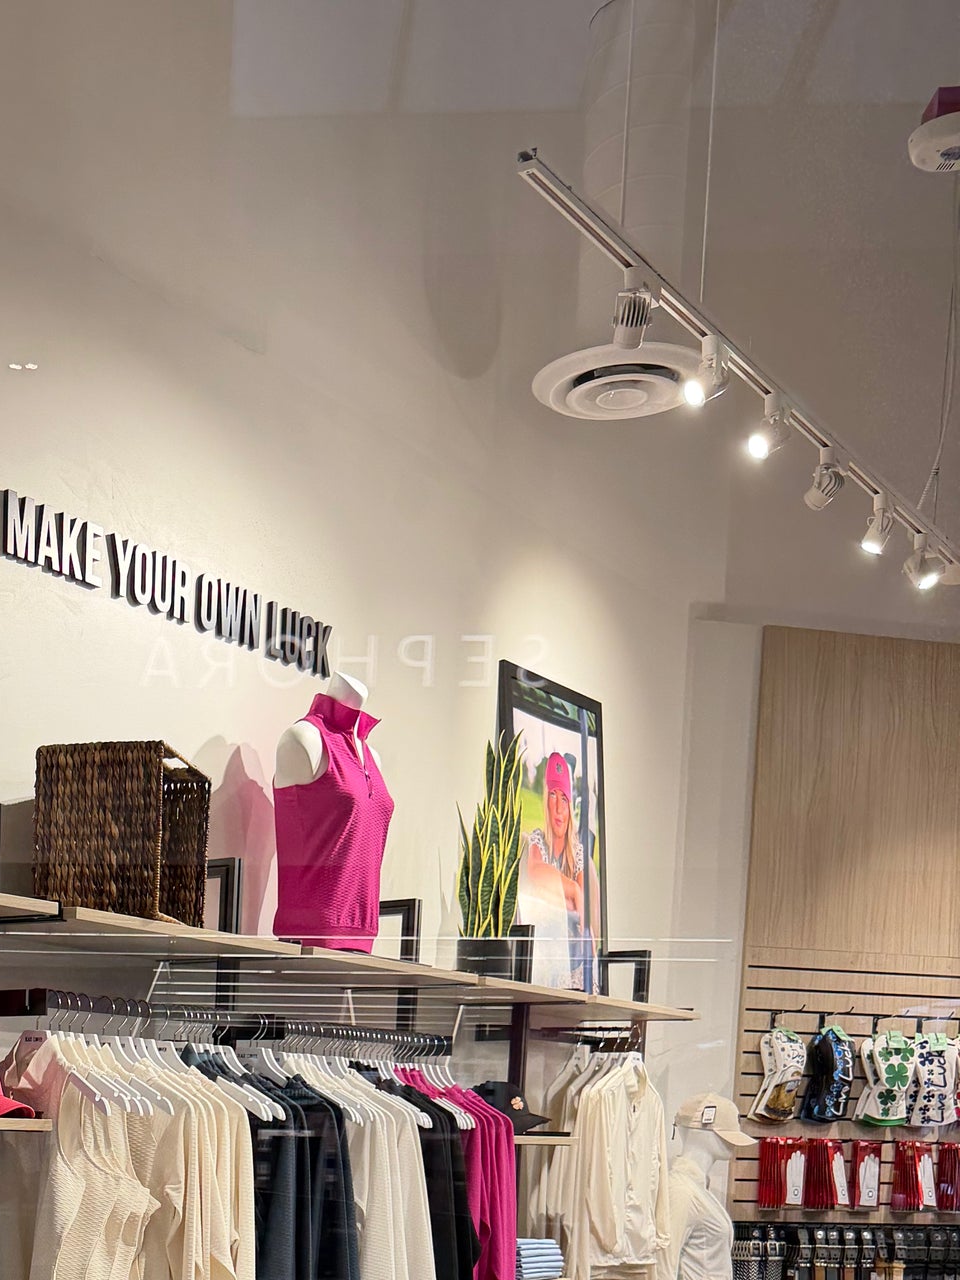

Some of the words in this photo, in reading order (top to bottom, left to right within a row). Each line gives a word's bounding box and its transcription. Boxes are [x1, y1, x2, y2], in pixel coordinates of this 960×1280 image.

[105, 533, 192, 625] YOUR
[194, 572, 262, 651] OWN
[264, 601, 333, 680] LUCK
[837, 1040, 853, 1081] Luck
[929, 1050, 947, 1088] Luck
[928, 1094, 947, 1124] Live
